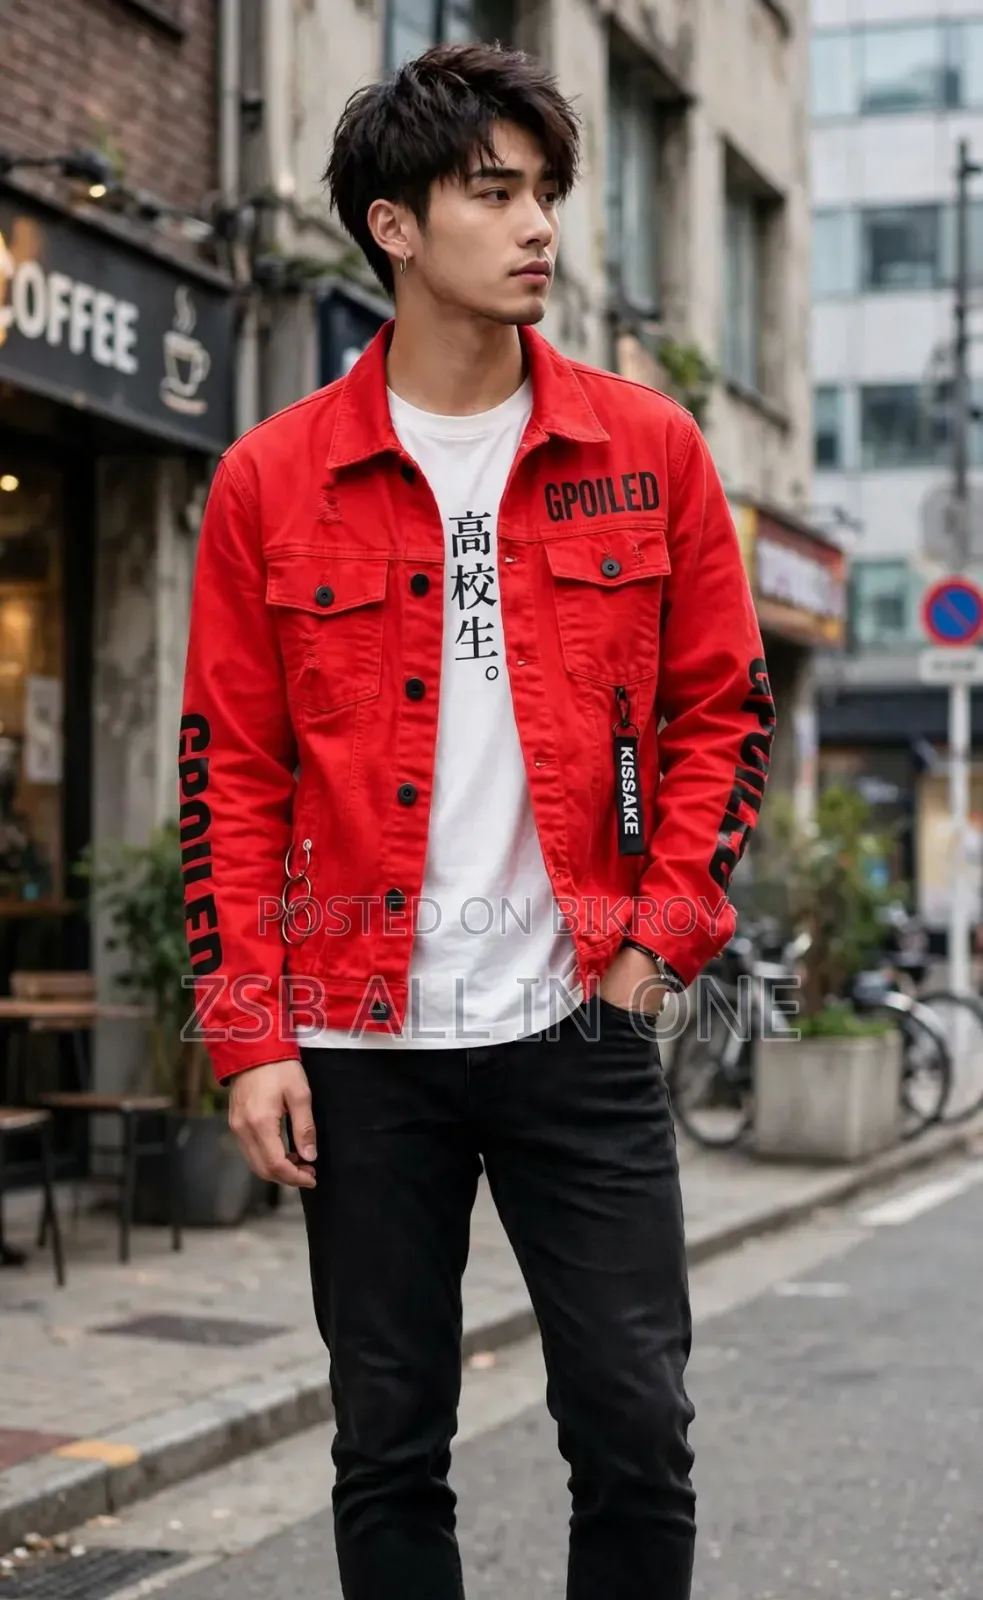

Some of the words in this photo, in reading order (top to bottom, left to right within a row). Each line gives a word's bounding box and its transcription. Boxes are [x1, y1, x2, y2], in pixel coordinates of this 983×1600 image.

[544, 471, 660, 522] GPOILED
[448, 511, 499, 681] 高校生。
[179, 713, 223, 976] GPOILED
[620, 746, 639, 835] KISSAKE
